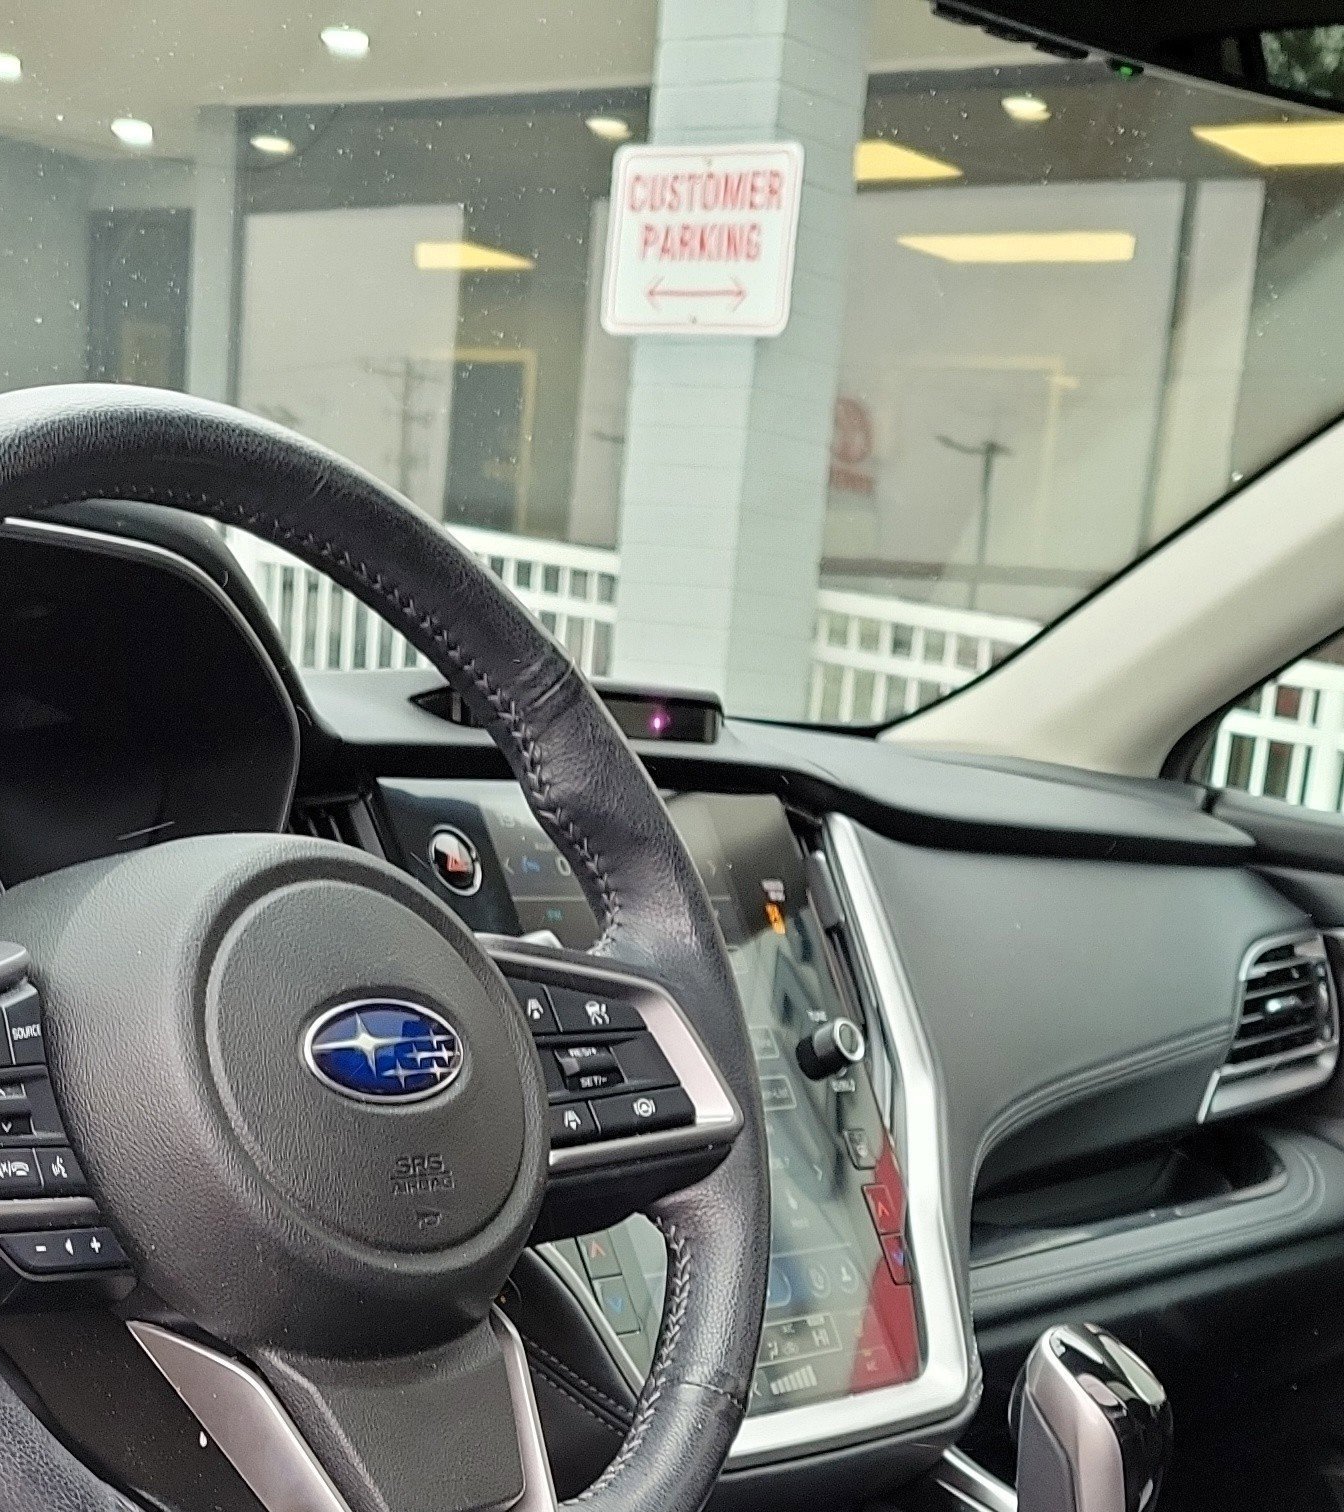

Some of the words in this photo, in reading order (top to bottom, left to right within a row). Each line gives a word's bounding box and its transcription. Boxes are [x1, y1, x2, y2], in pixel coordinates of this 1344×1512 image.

[628, 169, 783, 213] CUSTOMER
[640, 222, 762, 262] PARKING
[396, 1153, 446, 1175] SRS
